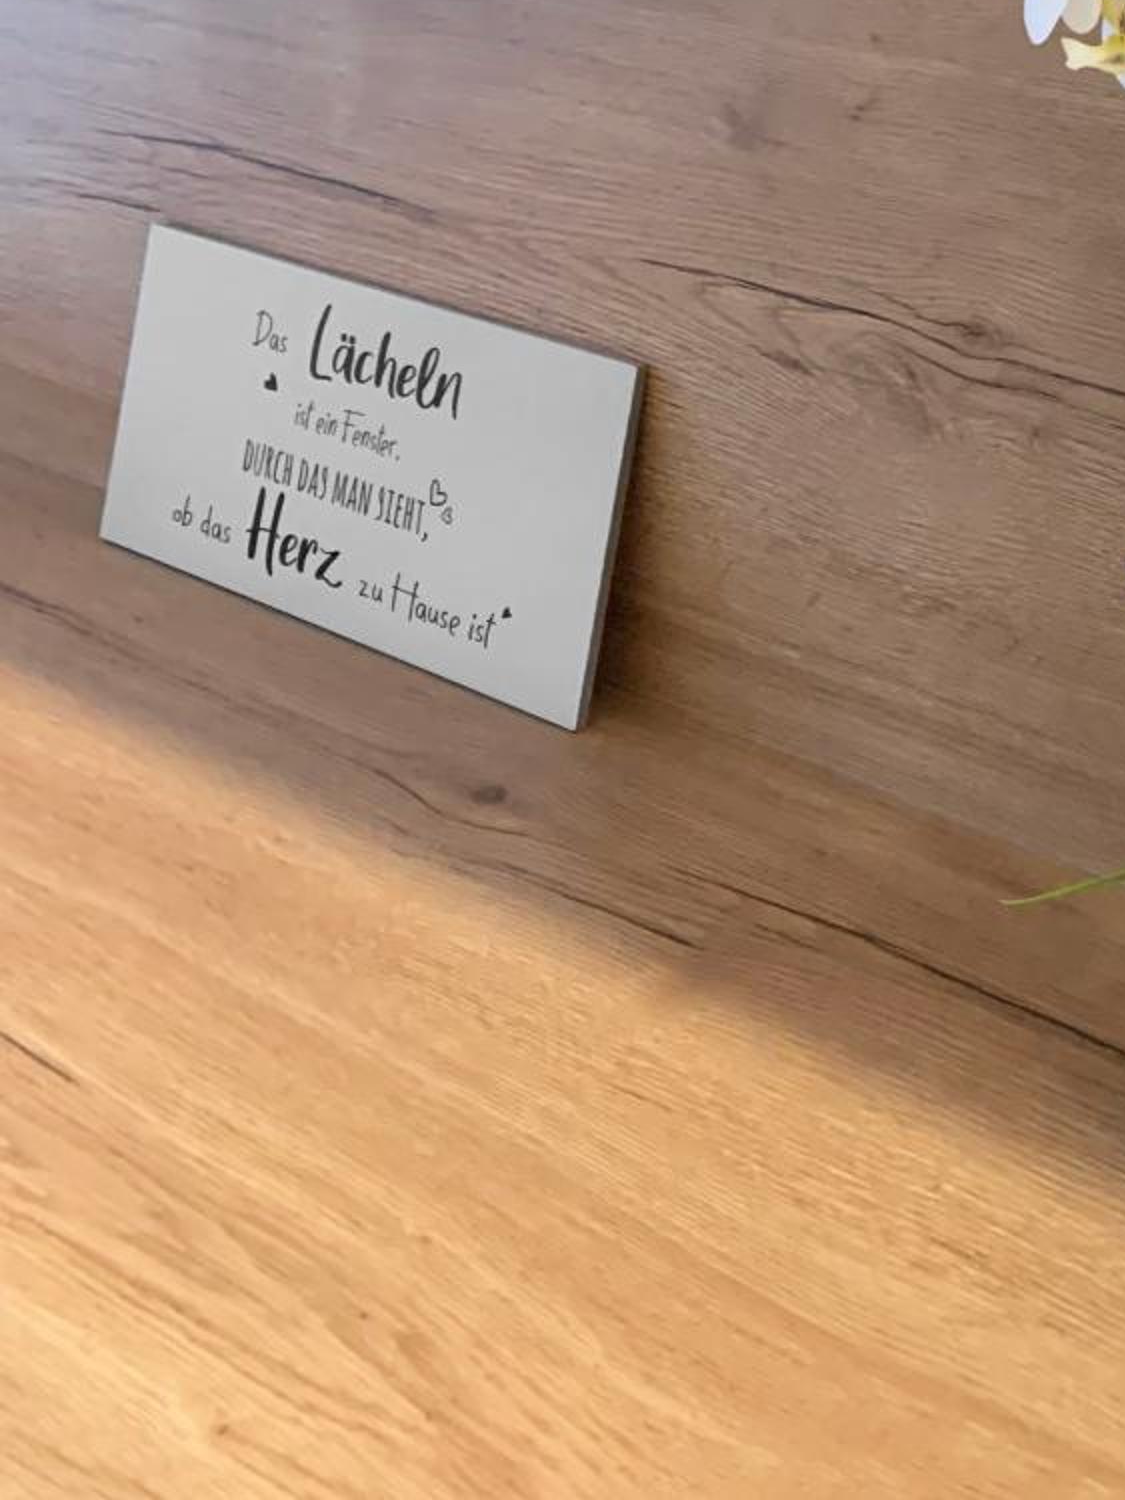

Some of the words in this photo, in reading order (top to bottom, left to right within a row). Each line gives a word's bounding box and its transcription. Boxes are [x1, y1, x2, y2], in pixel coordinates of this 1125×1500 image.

[252, 310, 288, 353] Das
[309, 303, 462, 420] Lächeln
[294, 401, 315, 430] ist
[316, 412, 338, 436] ein
[242, 438, 294, 486] DURCH
[297, 457, 328, 500] DAS
[331, 470, 373, 516] MAN
[375, 486, 428, 542] SIEHT,
[172, 494, 193, 527] ob
[200, 504, 232, 544] das
[245, 485, 342, 588] Herz
[358, 579, 383, 603] zu
[391, 572, 461, 637] Hause
[466, 613, 496, 649] ist
